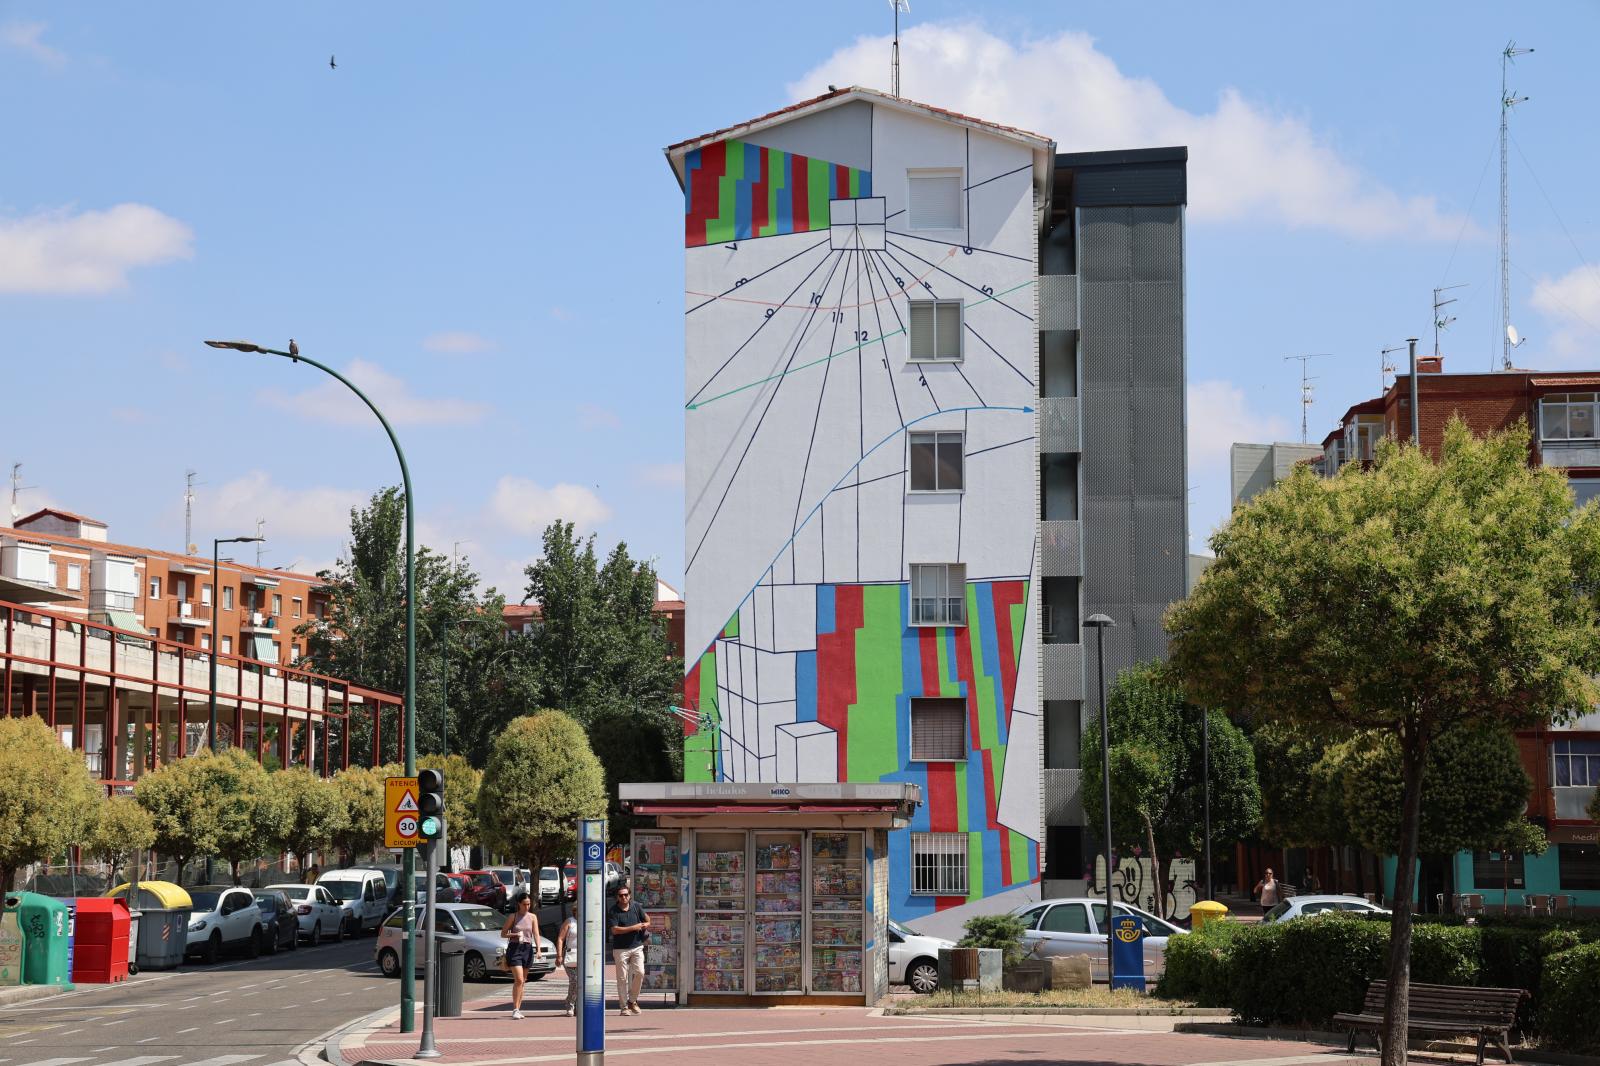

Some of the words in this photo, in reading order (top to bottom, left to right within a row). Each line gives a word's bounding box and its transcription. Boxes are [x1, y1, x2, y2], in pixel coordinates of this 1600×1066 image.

[962, 246, 973, 255] 6
[981, 284, 994, 296] 5
[810, 291, 823, 306] 10
[832, 311, 844, 324] 11
[854, 330, 868, 341] 12
[919, 375, 928, 387] 2
[770, 788, 791, 796] MIKO
[400, 822, 415, 831] 30
